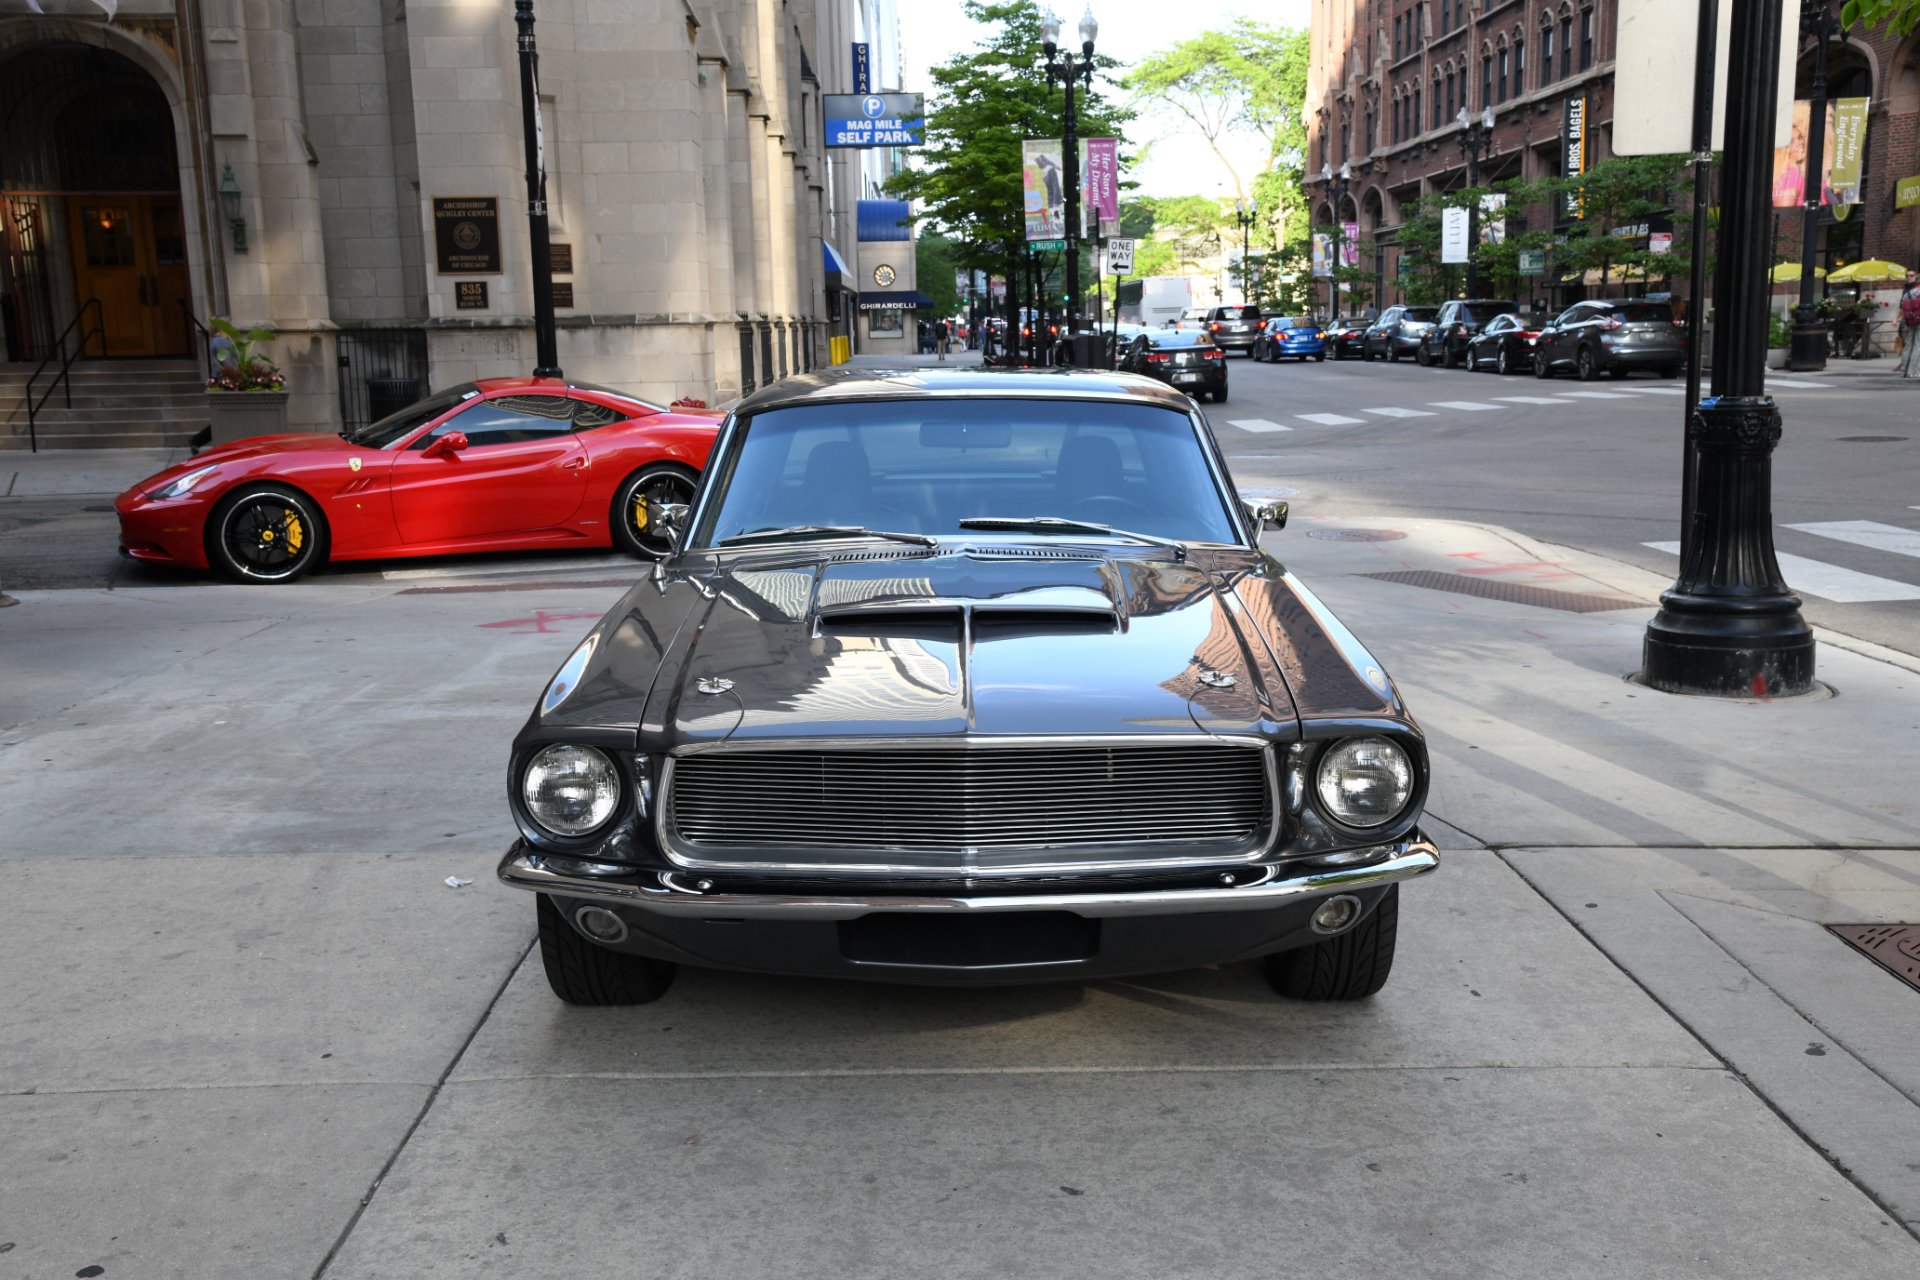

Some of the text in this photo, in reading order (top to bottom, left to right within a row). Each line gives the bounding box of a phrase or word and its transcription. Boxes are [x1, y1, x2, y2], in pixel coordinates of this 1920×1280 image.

[858, 45, 867, 94] GHIRA
[847, 119, 903, 130] MAG MILE
[1569, 99, 1583, 139] BAGELS
[837, 131, 912, 143] SELF PARK
[1836, 115, 1849, 170] Englewood
[1847, 115, 1861, 162] Everyday
[1089, 152, 1100, 167] My
[1102, 152, 1110, 171] Her
[1036, 241, 1055, 250] RUSH
[1111, 241, 1131, 251] ONE
[1110, 251, 1131, 260] WAY
[461, 283, 482, 294] 835
[860, 302, 916, 310] GHIRARDELLI
